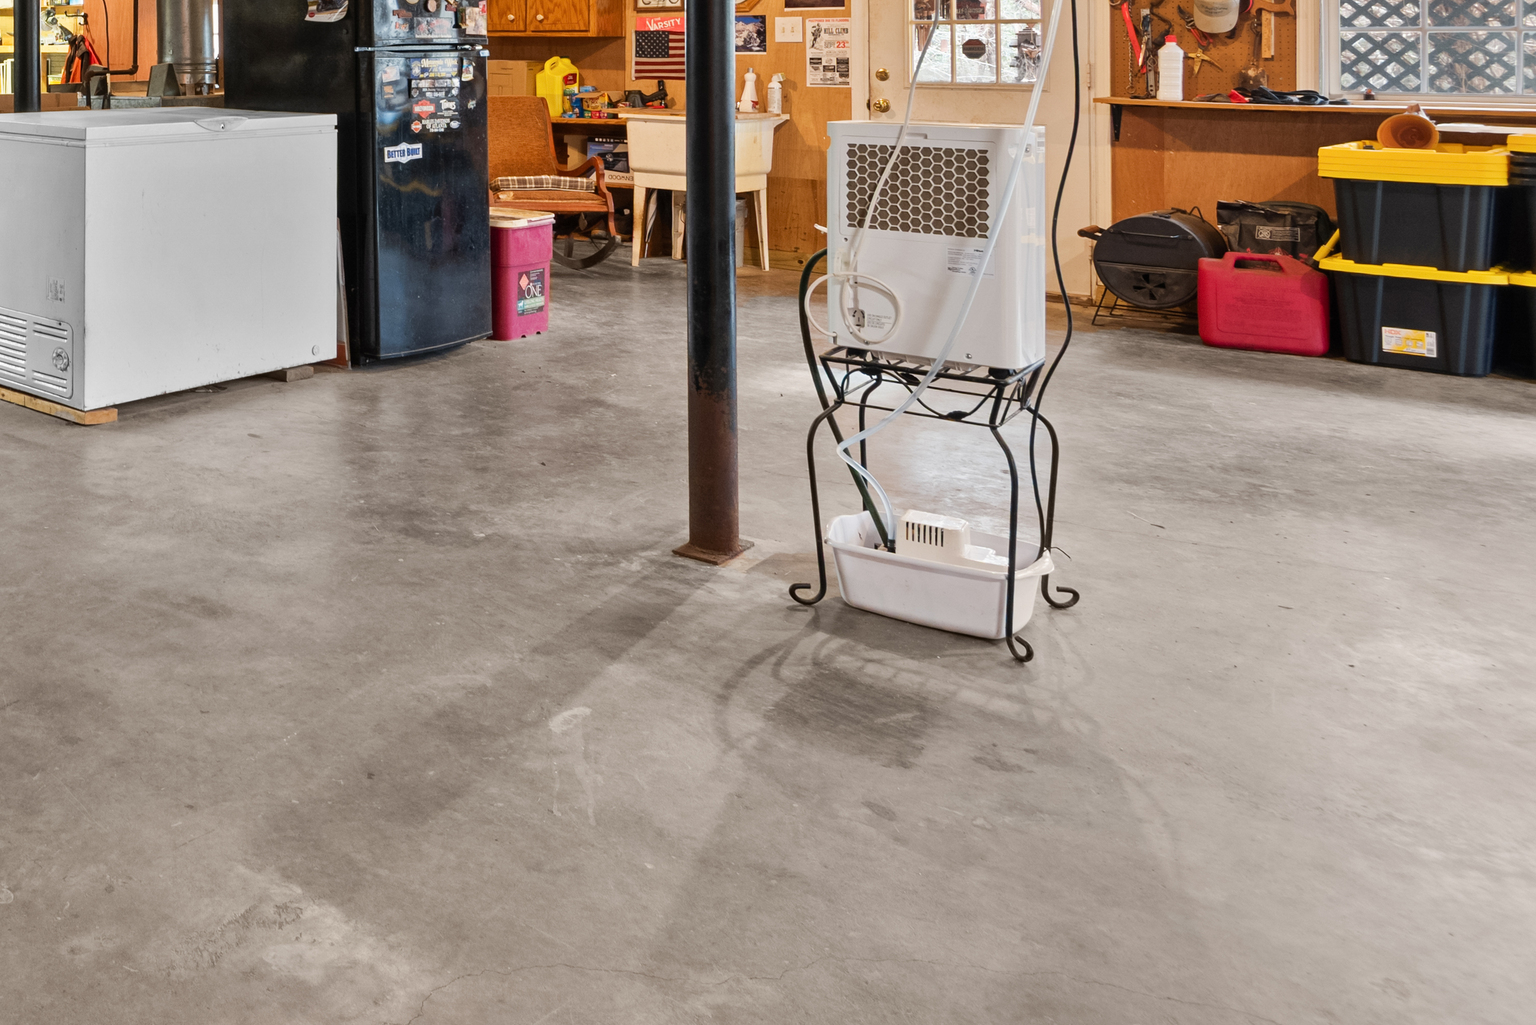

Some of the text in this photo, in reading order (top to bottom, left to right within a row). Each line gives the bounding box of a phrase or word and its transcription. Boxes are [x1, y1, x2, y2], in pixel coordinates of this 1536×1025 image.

[646, 18, 681, 31] VARSITY
[836, 40, 846, 49] 23
[387, 147, 421, 159] BETTER BUILT
[525, 284, 542, 299] ONE
